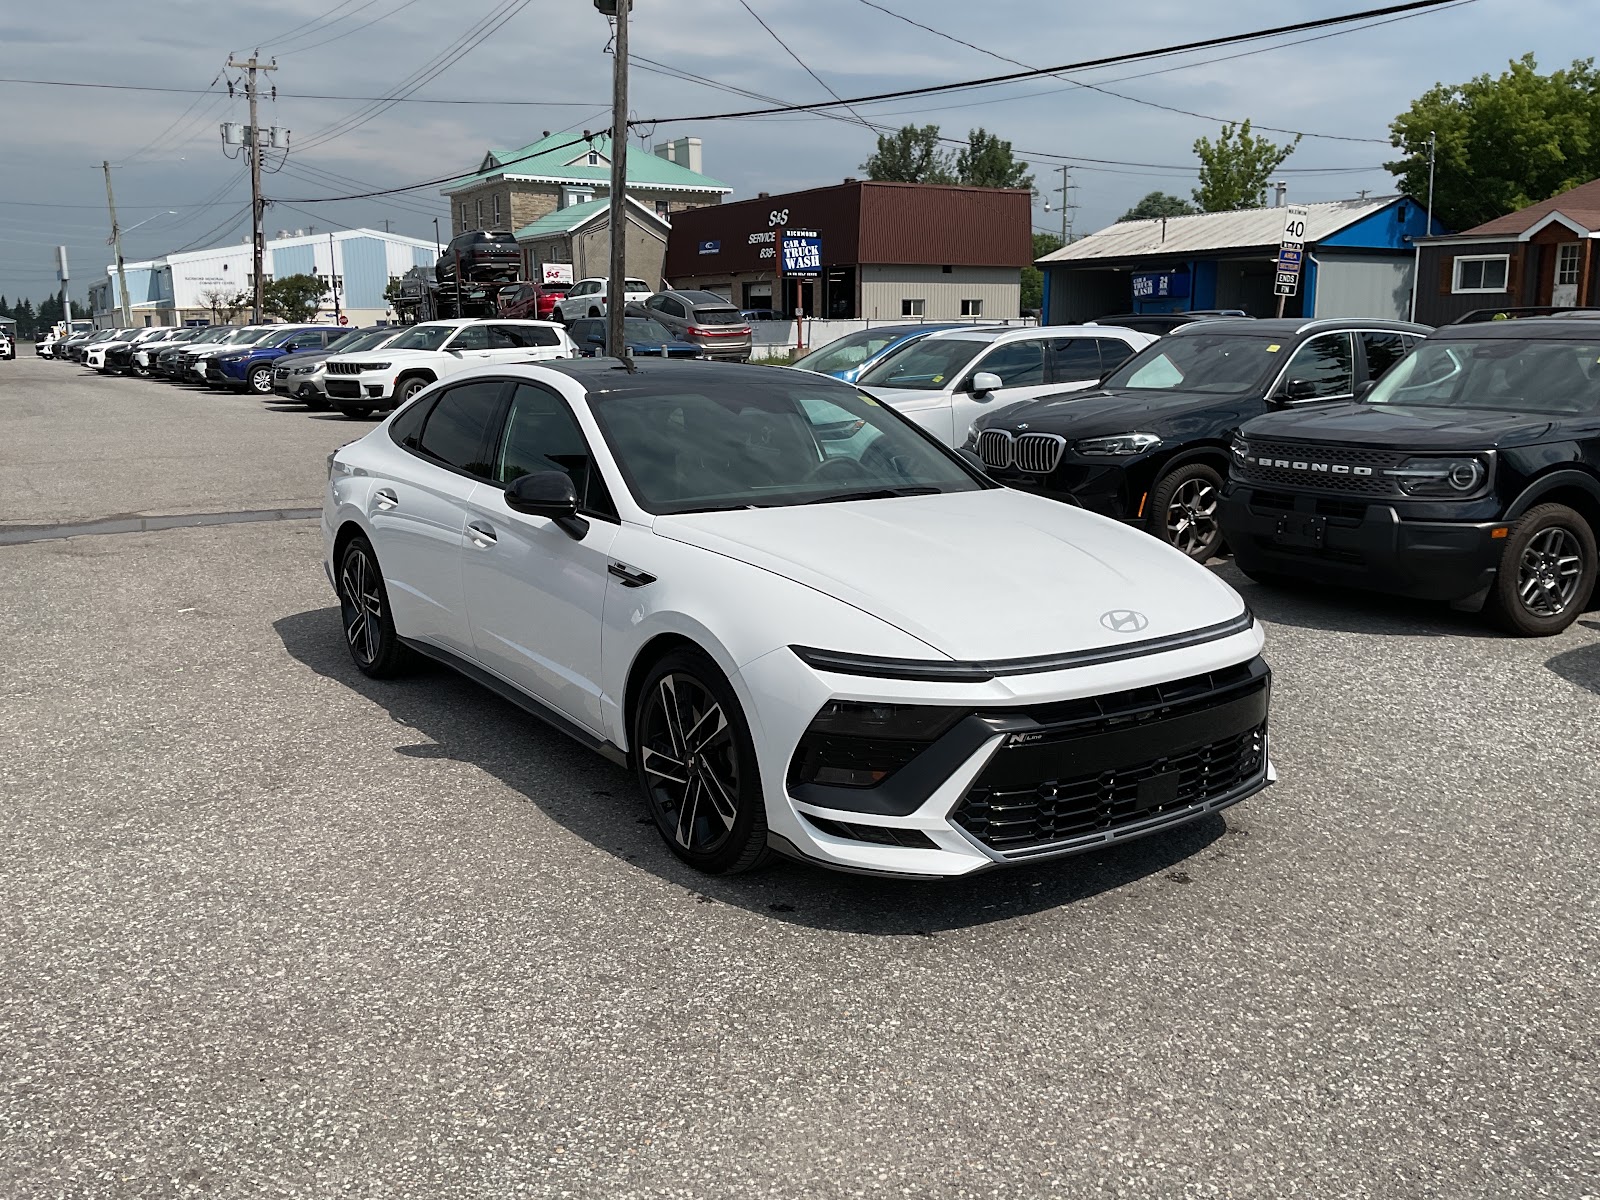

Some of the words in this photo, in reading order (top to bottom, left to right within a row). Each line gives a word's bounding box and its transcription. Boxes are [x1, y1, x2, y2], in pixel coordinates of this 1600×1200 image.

[768, 208, 789, 227] S&S
[786, 230, 817, 238] RICHMOND
[1285, 220, 1304, 237] 40
[748, 231, 776, 244] SERVICE
[783, 240, 799, 249] CAR
[800, 239, 807, 247] &
[784, 245, 819, 258] TRUCK
[1283, 252, 1298, 260] AREA
[785, 255, 821, 270] WASH
[1279, 274, 1295, 283] ENDS
[1280, 285, 1290, 294] FIN
[1258, 457, 1372, 476] BRONCO
[1009, 732, 1026, 744] N
